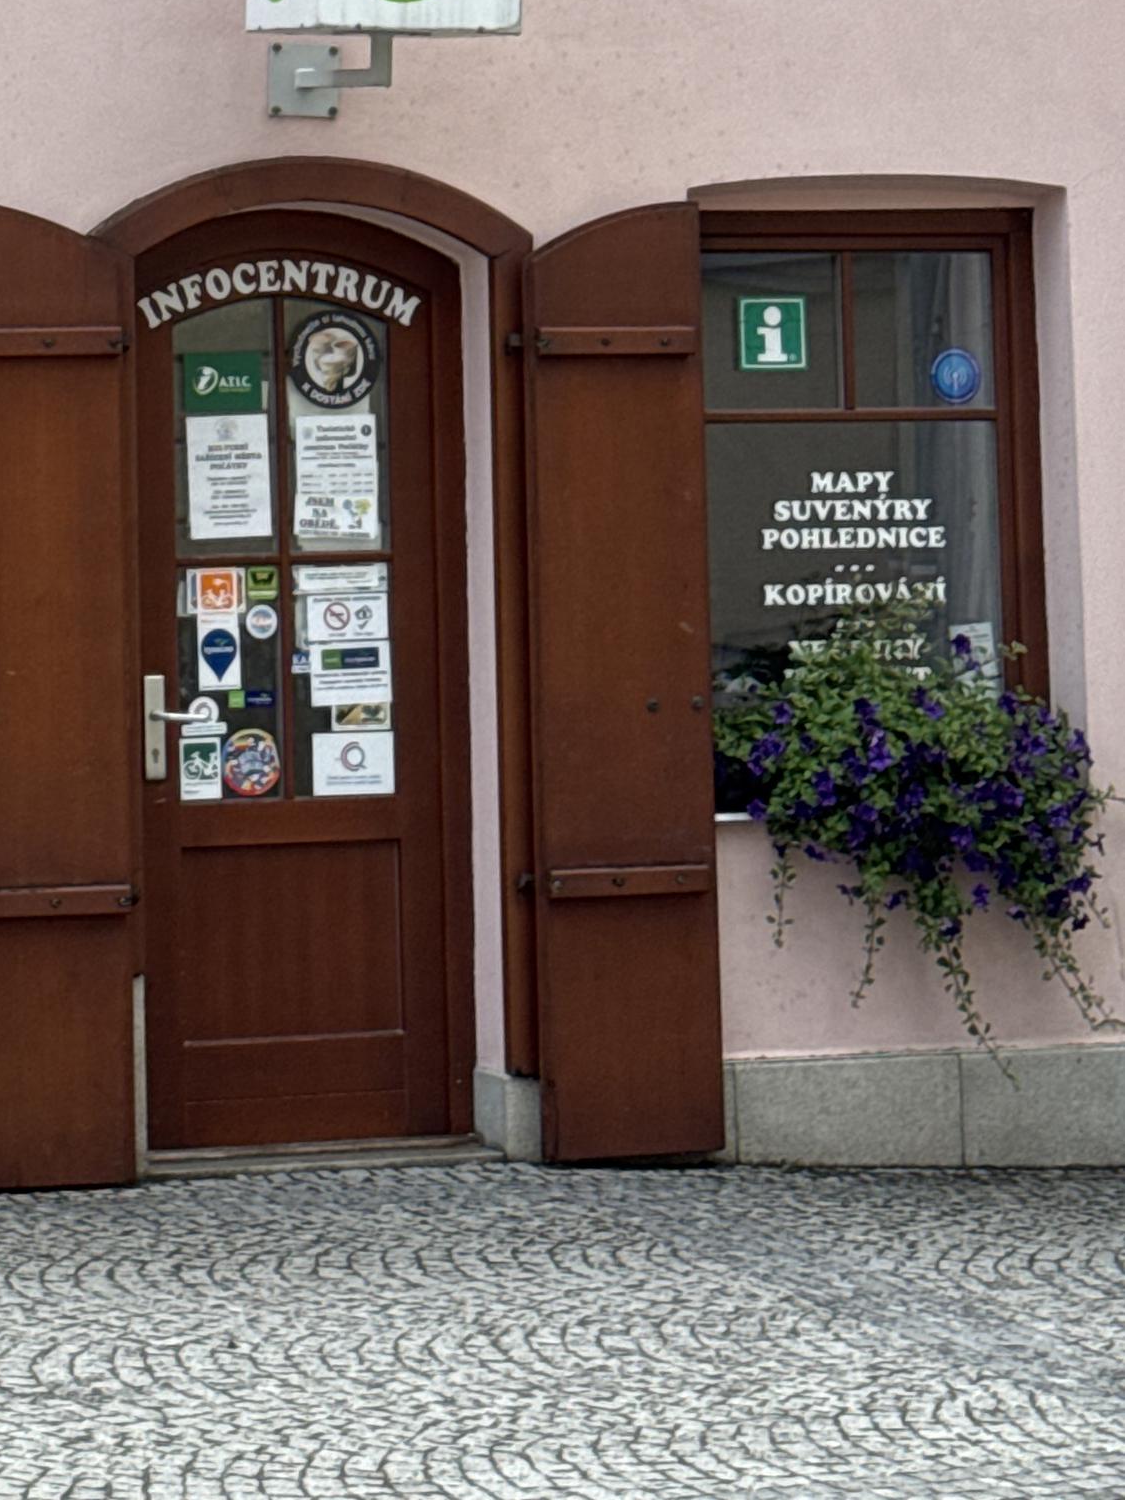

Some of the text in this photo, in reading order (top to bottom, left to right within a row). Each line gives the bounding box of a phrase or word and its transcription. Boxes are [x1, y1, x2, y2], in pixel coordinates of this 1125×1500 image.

[136, 259, 421, 329] INFOCENTRUM
[810, 471, 894, 493] MAPY
[774, 494, 932, 522] SUVENÝRY
[761, 526, 947, 550] POHLEDNICE
